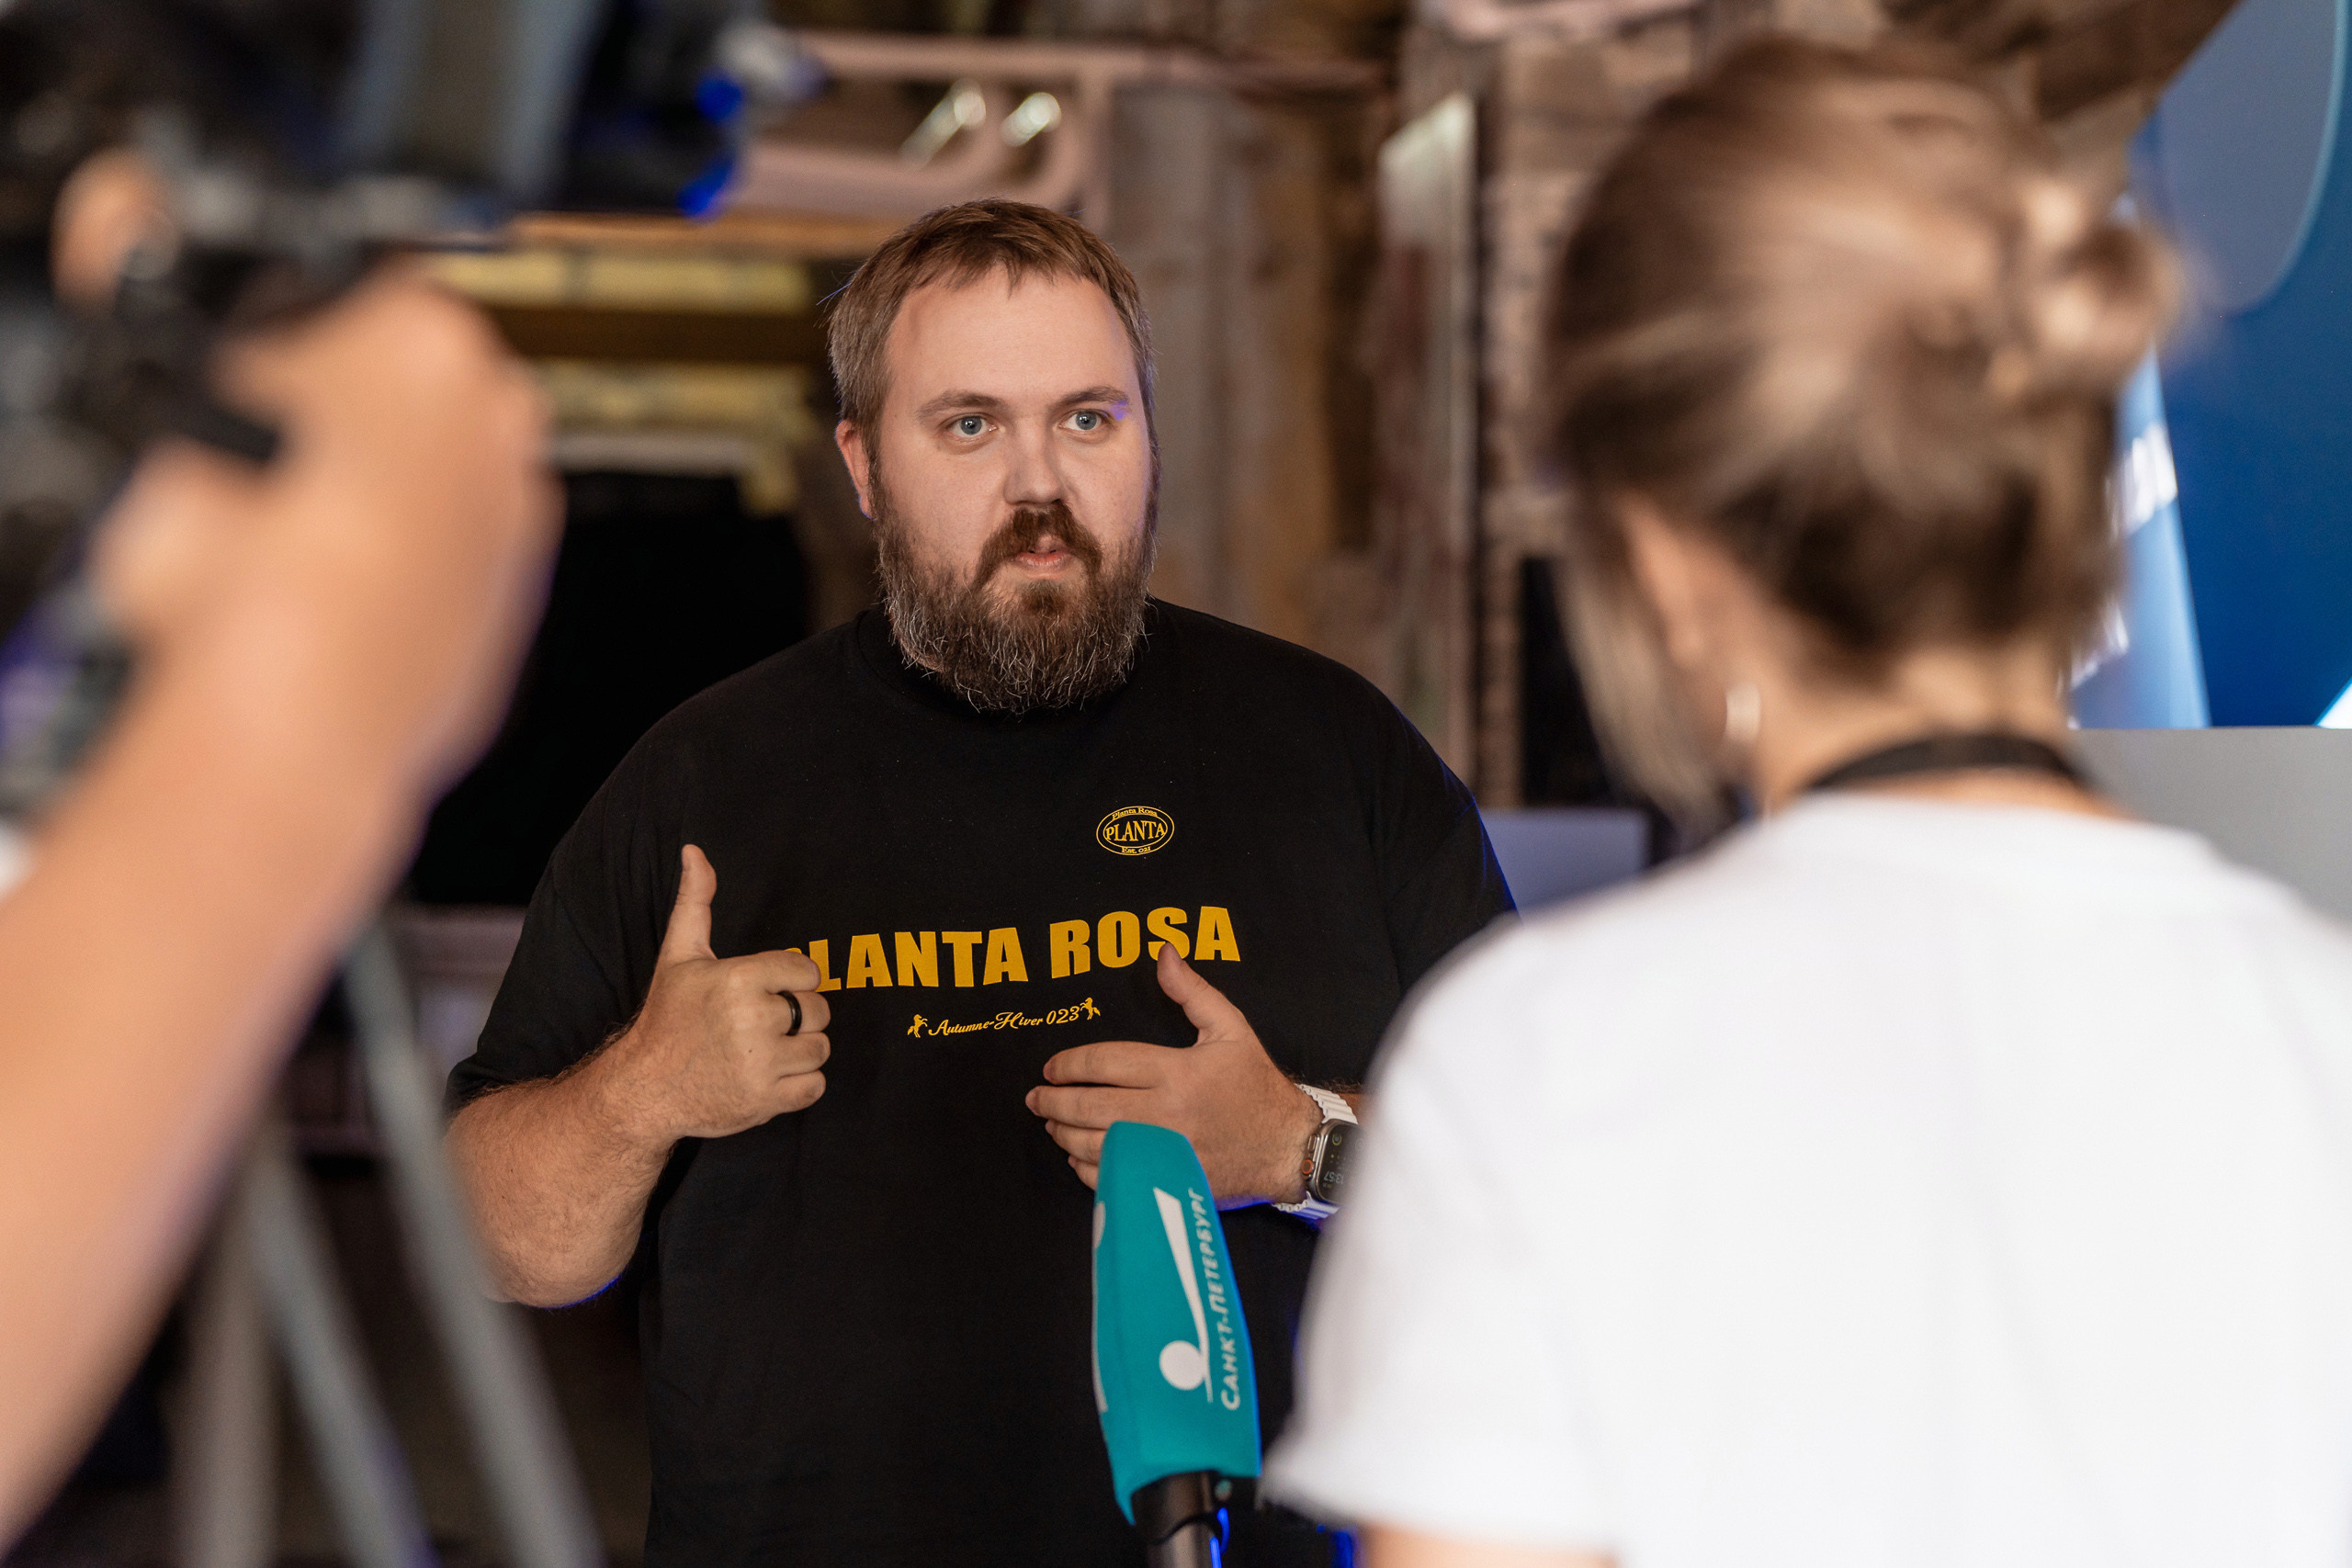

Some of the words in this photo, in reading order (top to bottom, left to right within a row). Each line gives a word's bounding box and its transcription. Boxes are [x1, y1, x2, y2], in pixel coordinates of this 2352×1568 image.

[1112, 808, 1136, 820] Planta
[1138, 807, 1159, 817] Rosa
[1105, 820, 1166, 841] PLANTA
[784, 927, 1029, 993] LANTA
[1049, 906, 1240, 979] ROSA
[1046, 1006, 1080, 1026] 023
